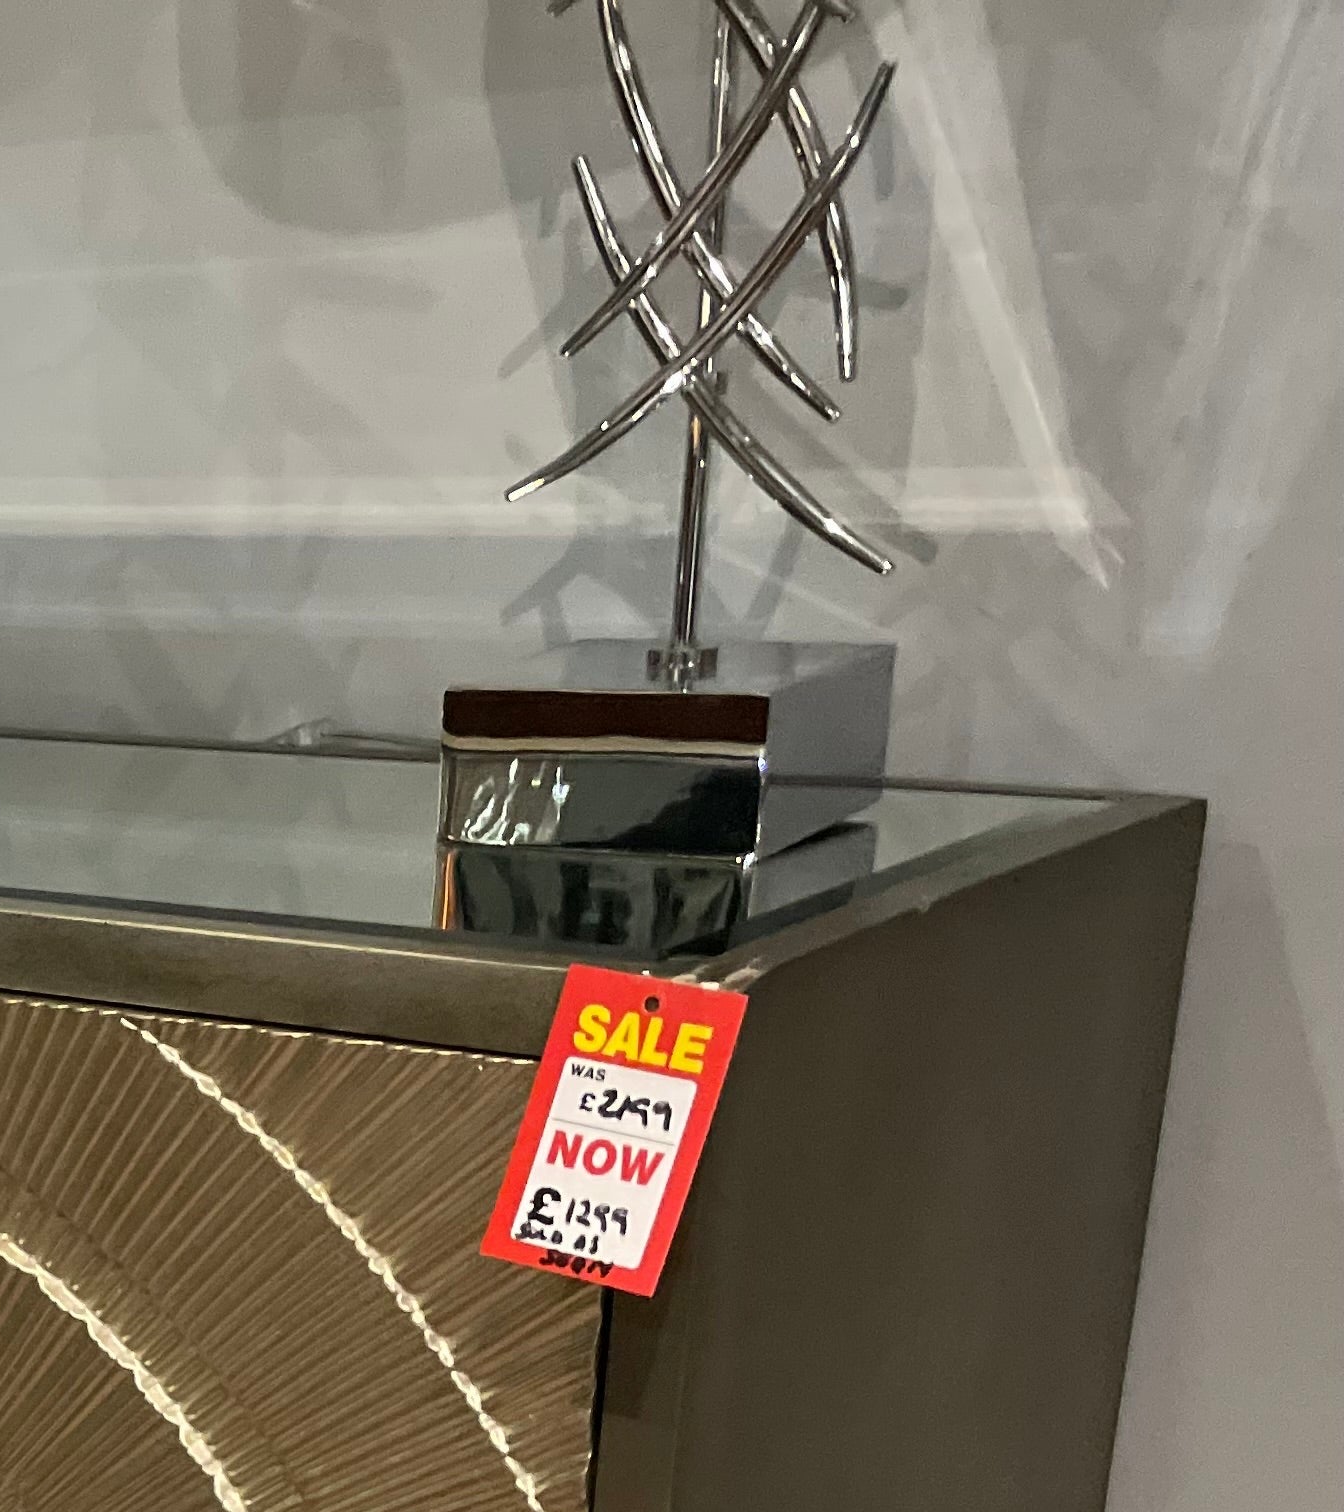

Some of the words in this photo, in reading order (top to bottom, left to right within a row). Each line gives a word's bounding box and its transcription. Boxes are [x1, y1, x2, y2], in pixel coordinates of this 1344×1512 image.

[573, 1003, 714, 1075] SALE
[570, 1062, 607, 1082] WAS
[546, 1130, 666, 1187] NOW
